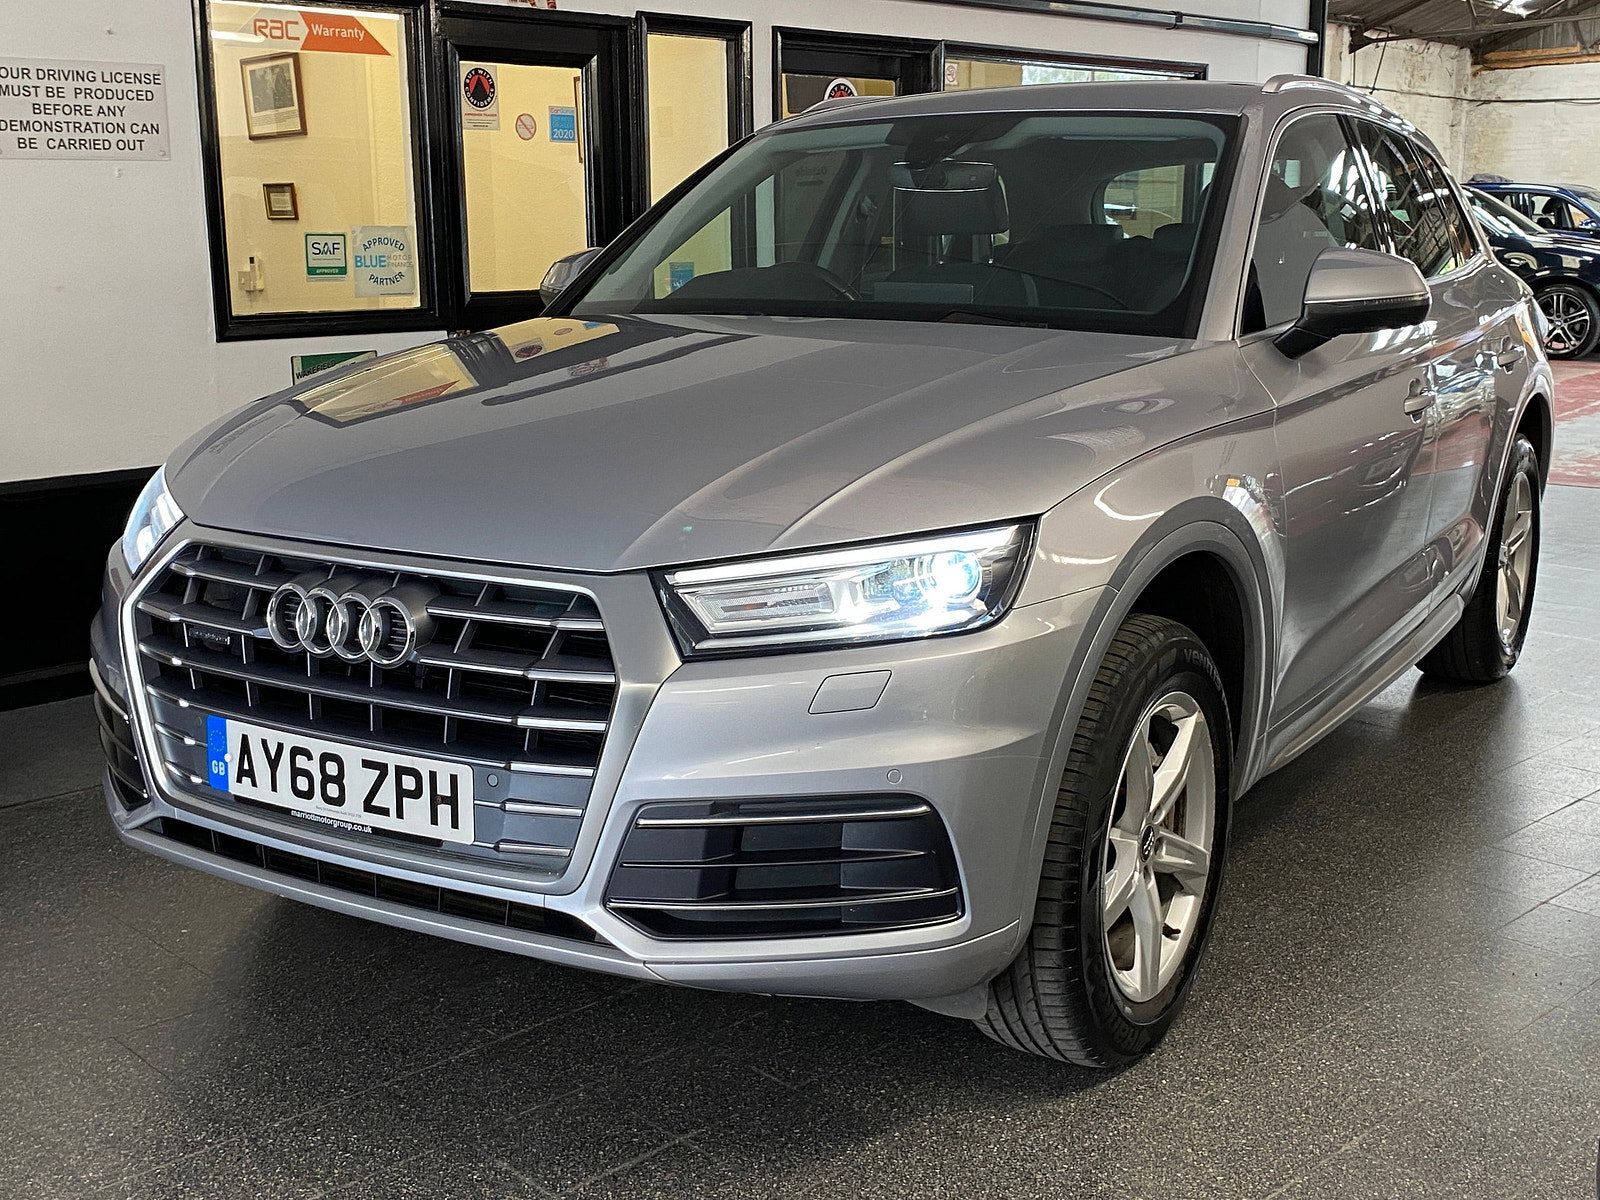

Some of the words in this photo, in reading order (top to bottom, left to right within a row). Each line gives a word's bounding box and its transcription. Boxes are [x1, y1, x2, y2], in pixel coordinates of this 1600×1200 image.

[253, 18, 300, 41] RAC
[311, 23, 366, 42] Warranty
[36, 69, 97, 83] DRIVING
[101, 71, 162, 86] LICENSE
[0, 84, 41, 98] MUST
[45, 87, 66, 99] BE
[74, 87, 155, 102] PRODUCED
[32, 103, 93, 117] BEFORE
[96, 105, 126, 117] ANY
[0, 119, 126, 135] DEMONSTRATION
[130, 122, 160, 135] CAN
[552, 128, 575, 139] 2020
[17, 137, 38, 150] BE
[46, 138, 112, 151] CARRIED
[116, 139, 145, 151] OUT
[362, 237, 405, 252] APPROVED
[354, 254, 387, 269] BLUE
[368, 271, 405, 286] PARTNER
[295, 359, 337, 380] WAKEFIELD
[211, 759, 226, 776] GB
[235, 733, 346, 808] AY68
[361, 758, 460, 830] ZPH
[290, 809, 373, 835] marriottmotorgroup.co.uk
